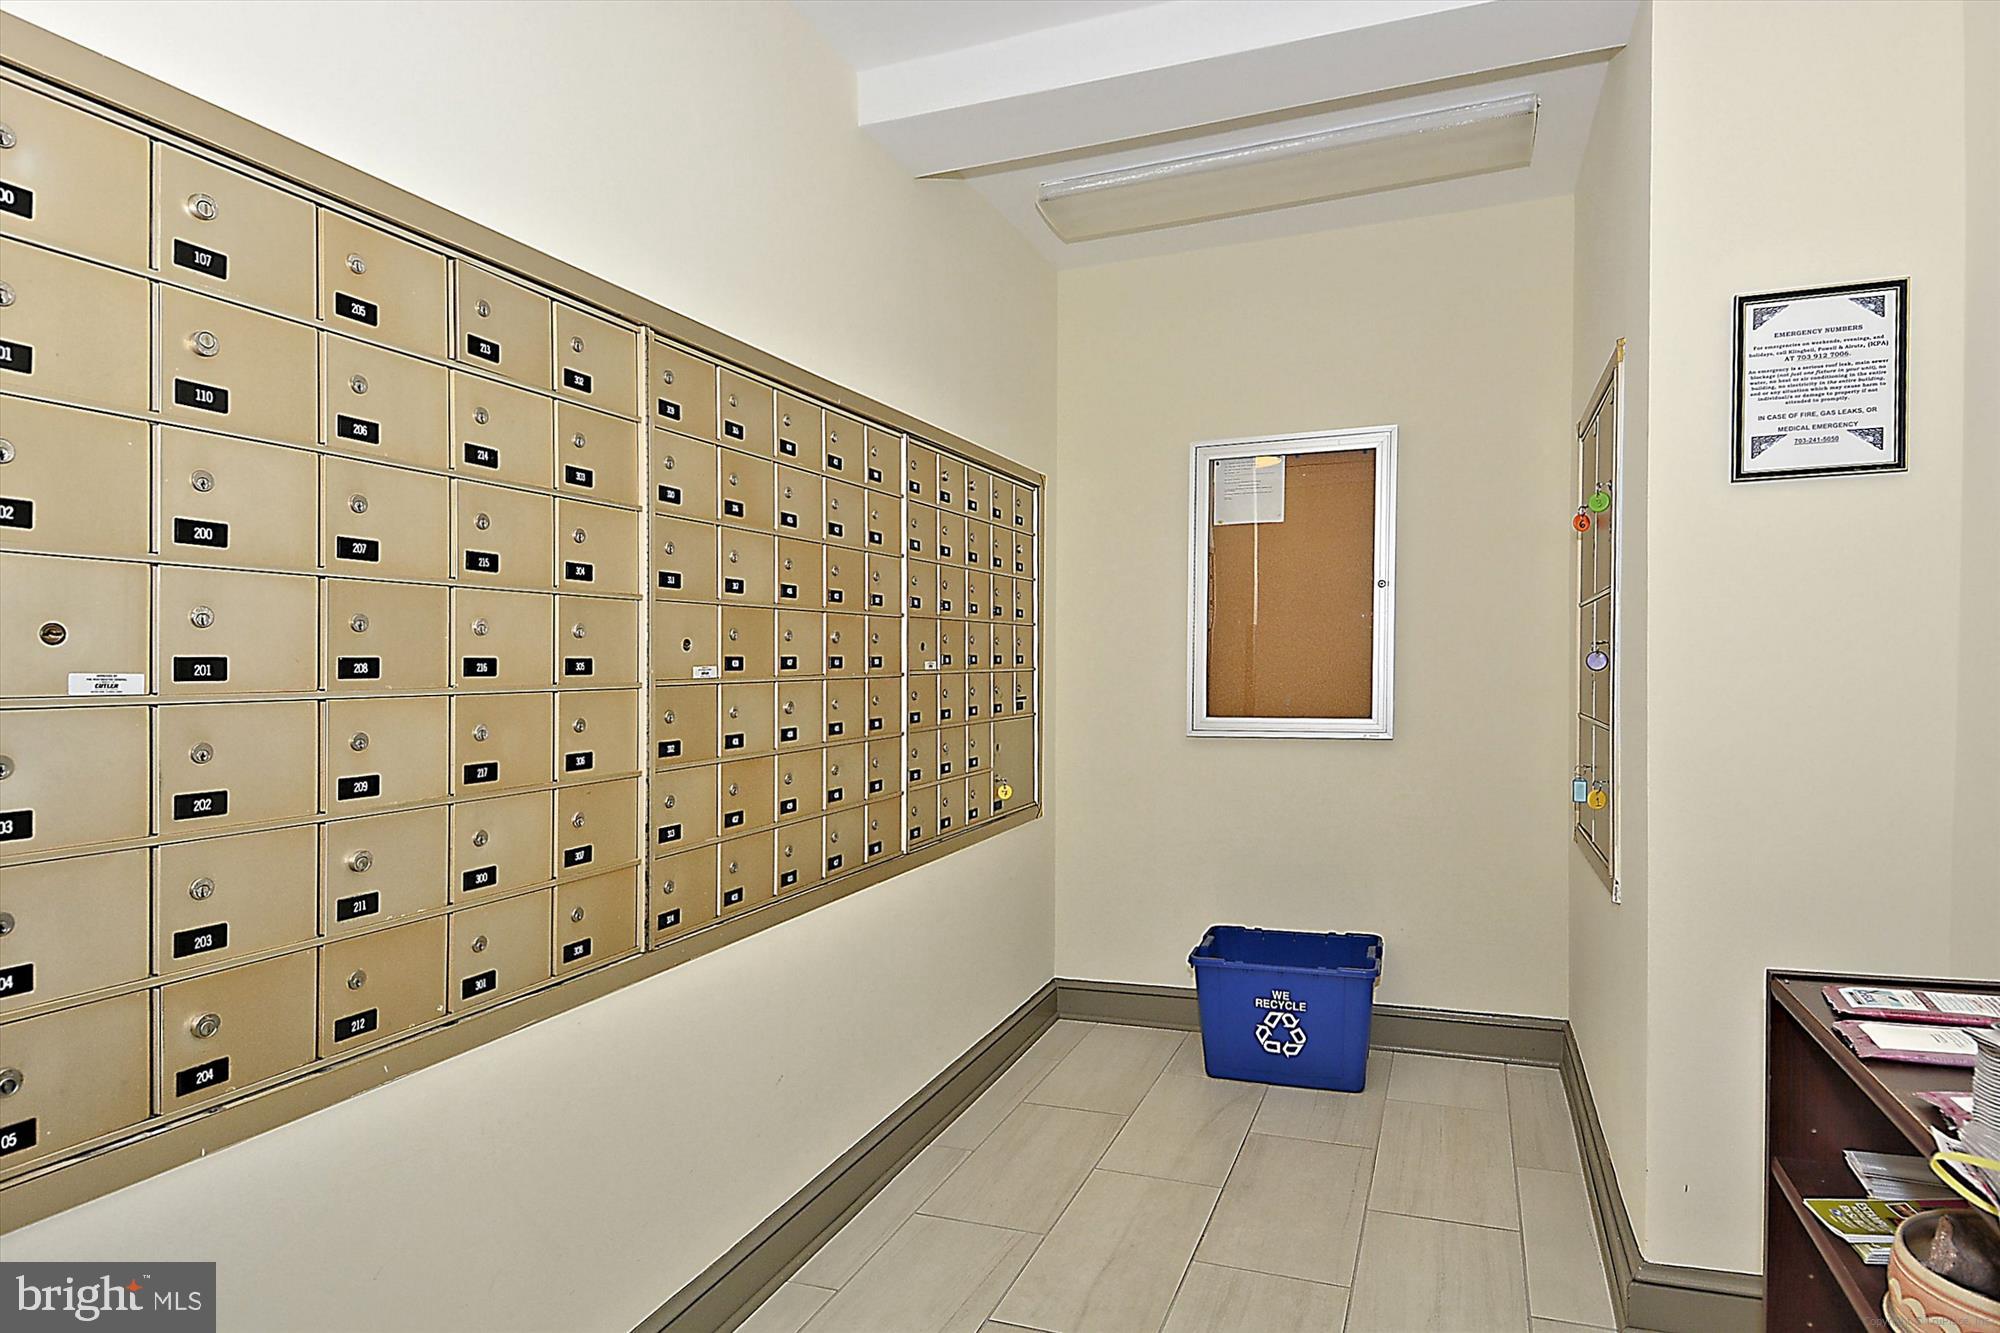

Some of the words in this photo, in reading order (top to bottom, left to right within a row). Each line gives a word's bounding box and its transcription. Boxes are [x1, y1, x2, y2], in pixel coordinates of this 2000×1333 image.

[195, 251, 211, 266] 107
[352, 303, 365, 316] 205
[1774, 328, 1822, 338] EMERGENCY
[1824, 324, 1864, 333] NUMBERS
[480, 343, 491, 354] 213
[1764, 342, 1801, 350] emergencies
[1811, 338, 1842, 346] weekends,
[1867, 340, 1889, 348] (KPA)
[1814, 368, 1836, 376] fixture
[196, 389, 213, 403] 110
[1834, 388, 1860, 396] property
[1820, 396, 1850, 404] promptly.
[1838, 408, 1864, 416] LEAKS,
[353, 424, 367, 436] 206
[1812, 421, 1859, 430] EMERGENCY
[478, 450, 488, 460] 214
[1579, 520, 1586, 528] 6
[194, 527, 212, 539] 200
[353, 543, 366, 553] 207
[479, 558, 489, 567] 215
[194, 665, 211, 676] 201
[354, 663, 368, 673] 208
[477, 768, 487, 778] 217
[354, 781, 368, 792] 209
[194, 799, 211, 811] 202
[476, 873, 487, 883] 300
[354, 900, 366, 912] 211
[195, 934, 212, 949] 203
[476, 979, 486, 990] 301
[1272, 990, 1290, 1001] WE
[1255, 998, 1307, 1012] RECYCLE
[352, 1018, 365, 1032] 212
[197, 1069, 213, 1084] 204
